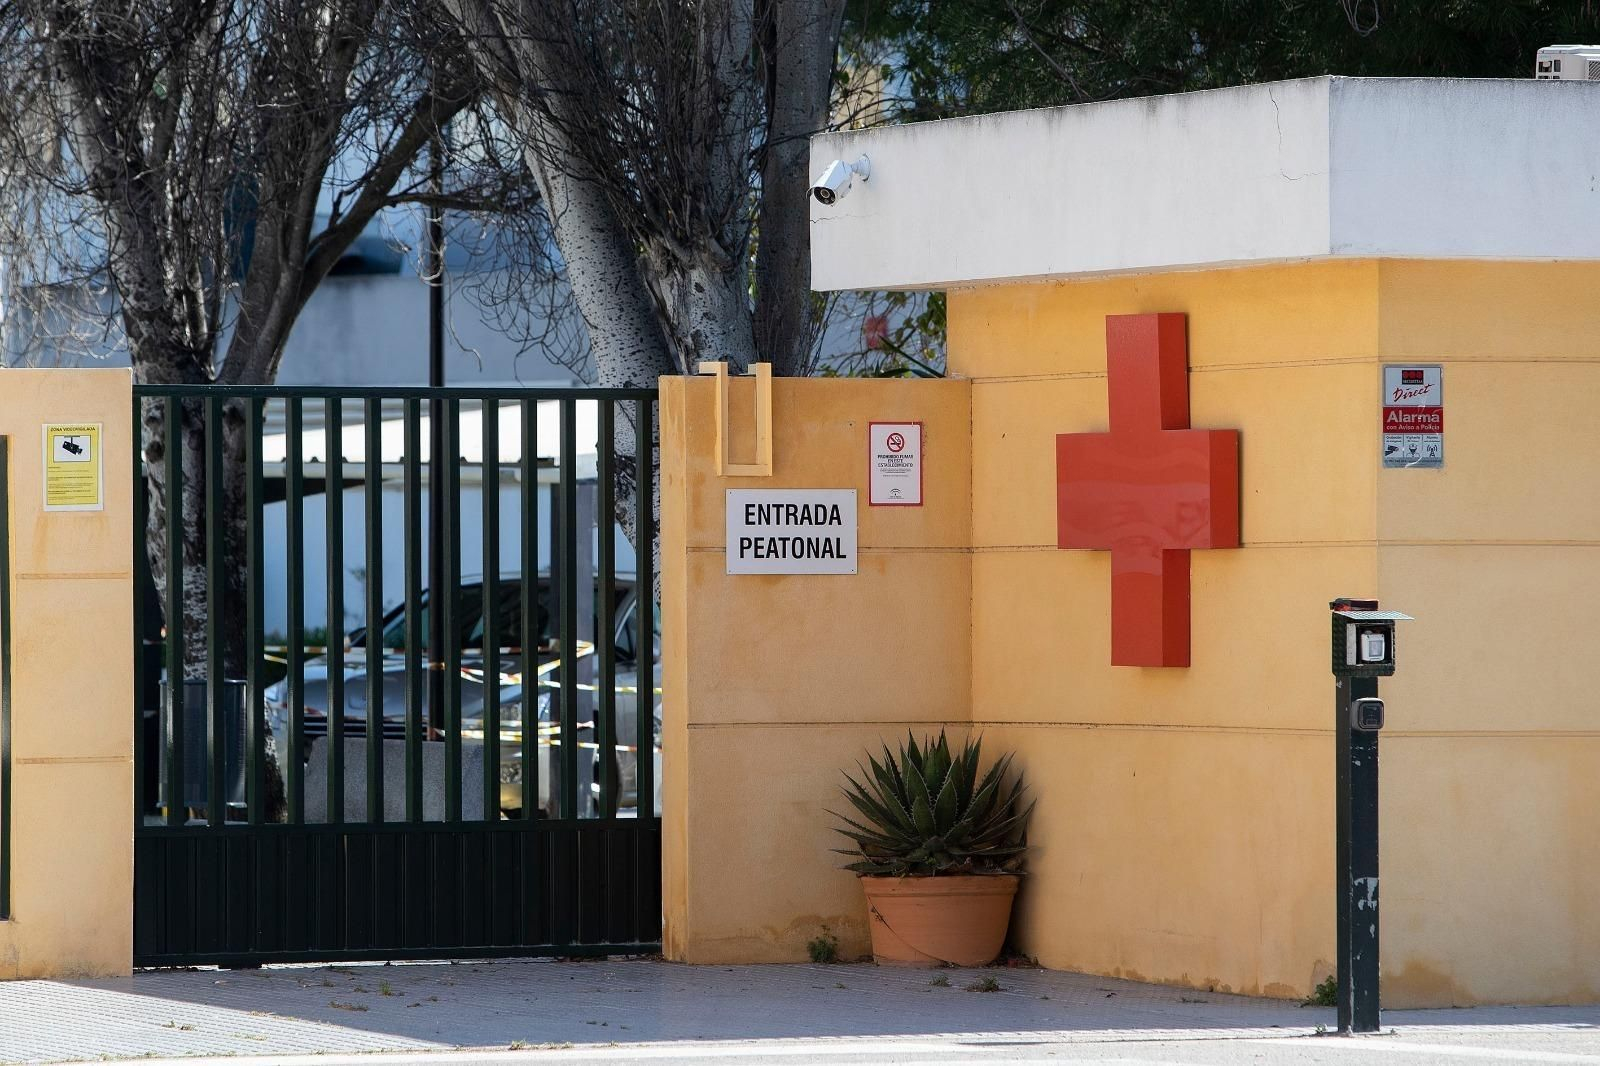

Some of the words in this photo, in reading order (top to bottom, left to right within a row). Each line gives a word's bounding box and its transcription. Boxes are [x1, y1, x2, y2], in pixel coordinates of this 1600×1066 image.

[1393, 384, 1435, 402] Direct
[1387, 410, 1440, 423] Alarma
[744, 503, 842, 526] ENTRADA
[739, 536, 847, 559] PEATONAL
